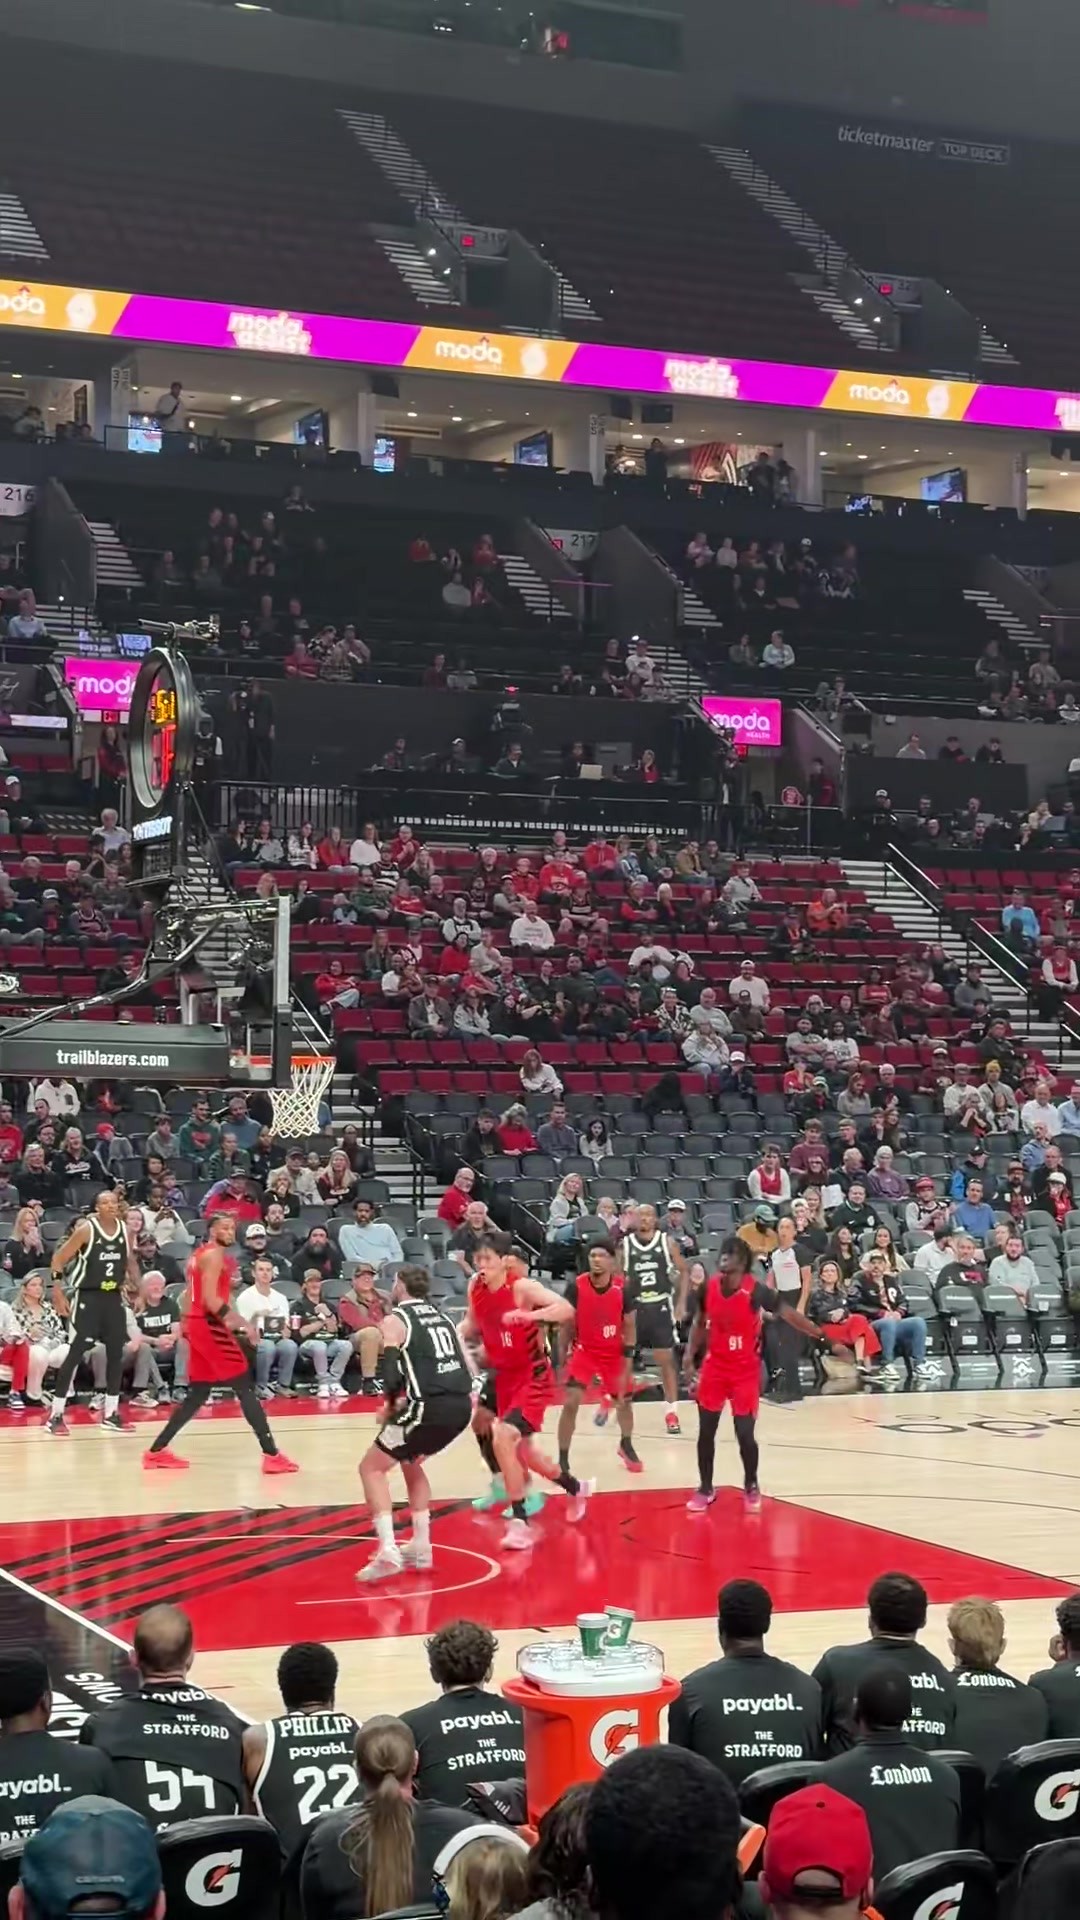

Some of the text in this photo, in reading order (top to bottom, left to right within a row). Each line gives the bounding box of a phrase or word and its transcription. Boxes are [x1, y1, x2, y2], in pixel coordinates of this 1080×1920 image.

[838, 125, 935, 152] ticketmaster
[226, 311, 304, 338] moda
[435, 338, 502, 364] moda
[849, 381, 910, 405] moda
[4, 487, 35, 502] 216
[713, 711, 770, 732] moda
[56, 1049, 169, 1067] trailblazers.com
[105, 1262, 114, 1277] 2
[640, 1271, 657, 1287] 23
[427, 1326, 455, 1358] 10
[957, 1672, 1017, 1688] London
[176, 1713, 197, 1722] THE
[142, 1724, 230, 1740] STRATFORD
[754, 1730, 774, 1741] THE
[477, 1738, 497, 1748] THE
[724, 1744, 803, 1758] STRATFORD
[447, 1748, 527, 1771] STRATFORD
[869, 1763, 933, 1785] London
[293, 1764, 359, 1825] 22
[14, 1814, 36, 1826] THE
[186, 1849, 242, 1906] G
